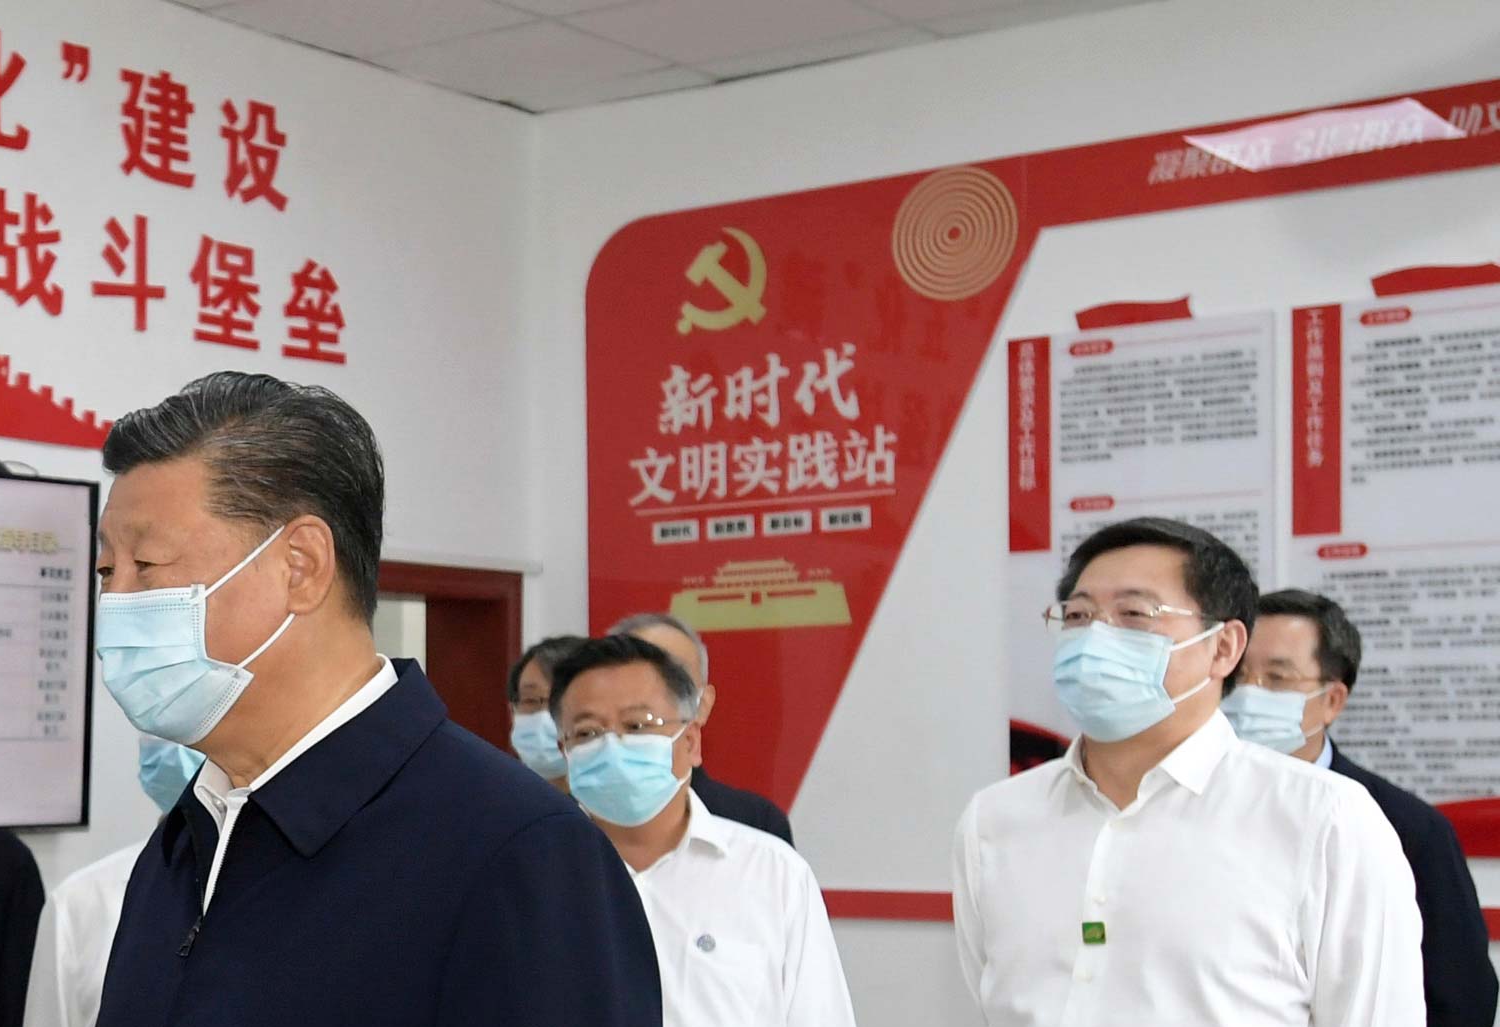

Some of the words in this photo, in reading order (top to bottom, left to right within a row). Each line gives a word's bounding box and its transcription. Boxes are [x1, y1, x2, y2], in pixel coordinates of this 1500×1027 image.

[658, 342, 860, 435] 新时代
[629, 425, 897, 506] 文明实践站
